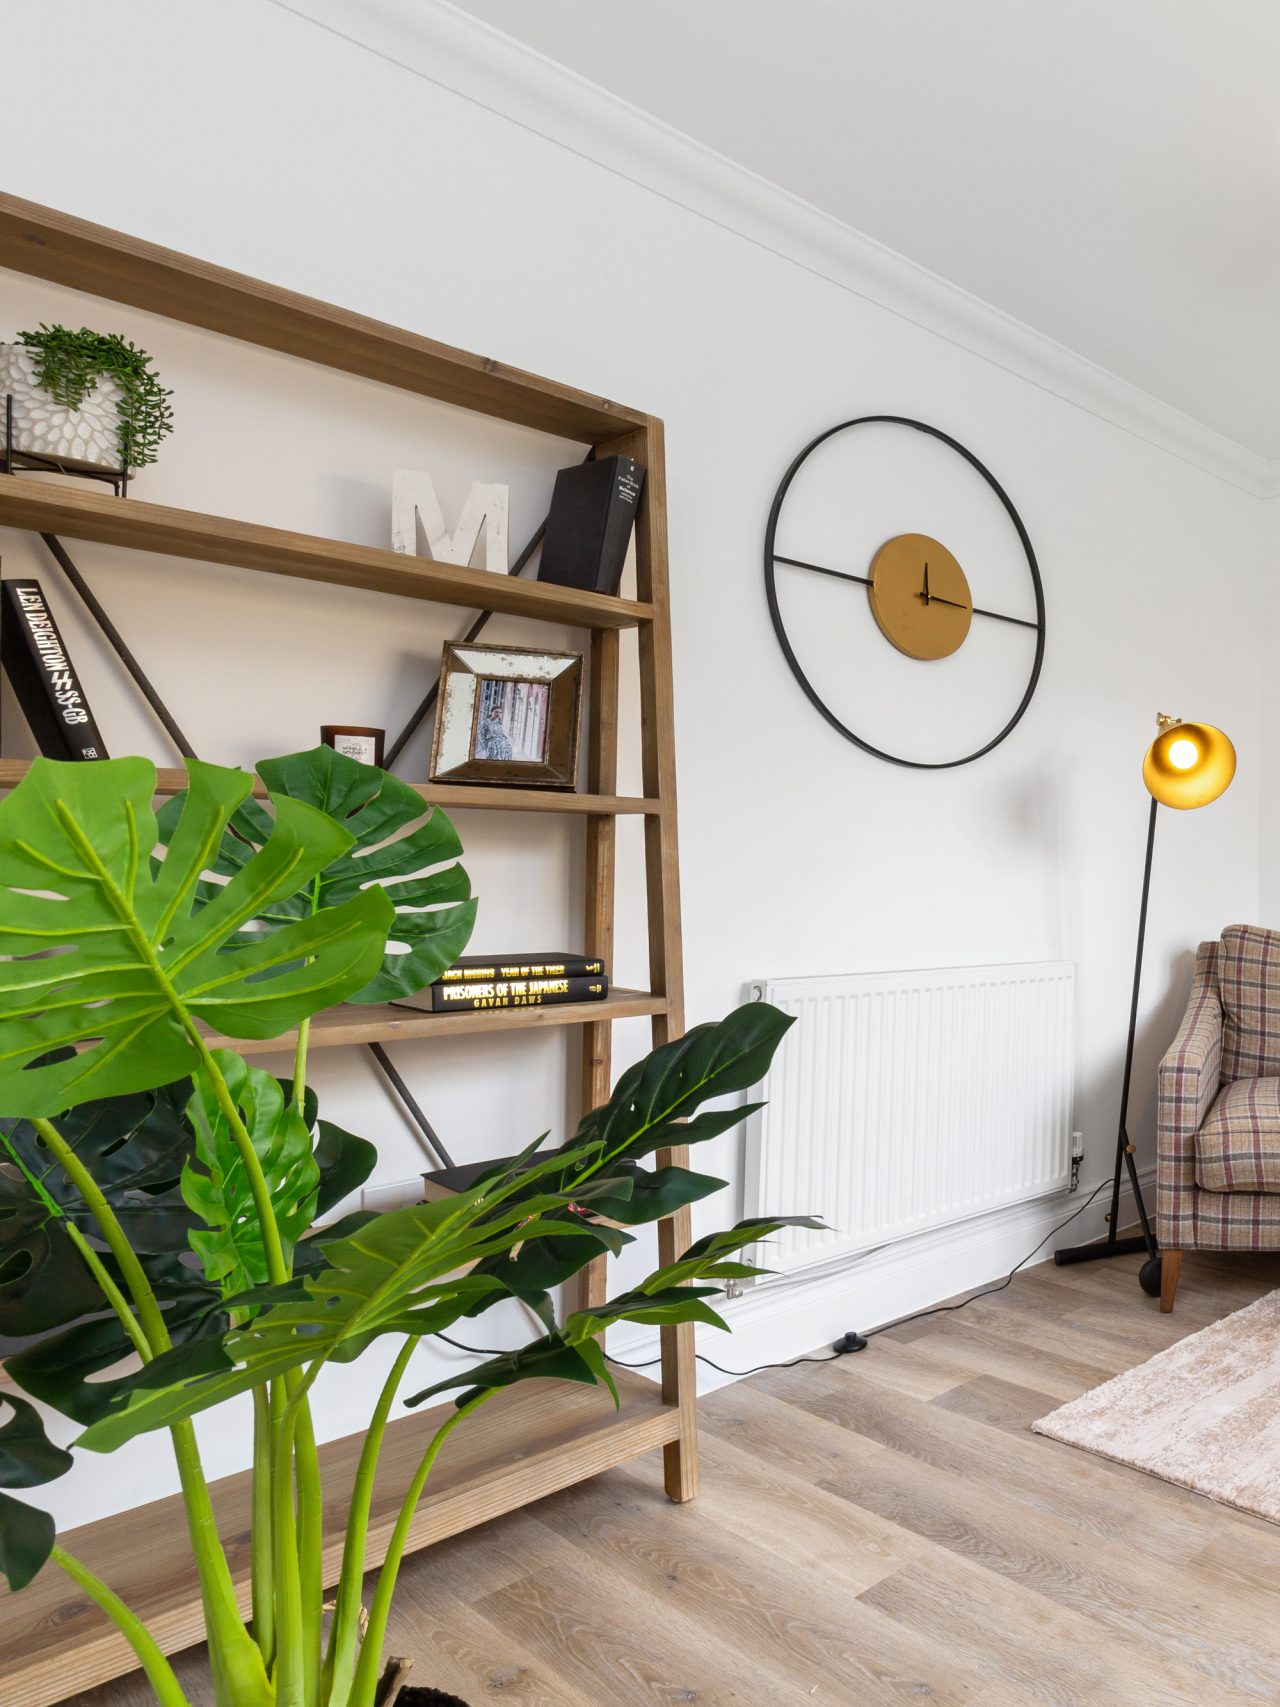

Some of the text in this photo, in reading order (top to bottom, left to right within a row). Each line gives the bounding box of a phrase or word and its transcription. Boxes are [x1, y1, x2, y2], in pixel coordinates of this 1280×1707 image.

[392, 467, 509, 575] M
[15, 587, 89, 725] LEN DEIGHTON SS-GB
[442, 964, 565, 981] JACK HIGGINS YEAR OF THE TIGER
[443, 980, 568, 1000] PRISONERS OF THE JAPANESE
[473, 995, 542, 1008] GAVAN DAWS
